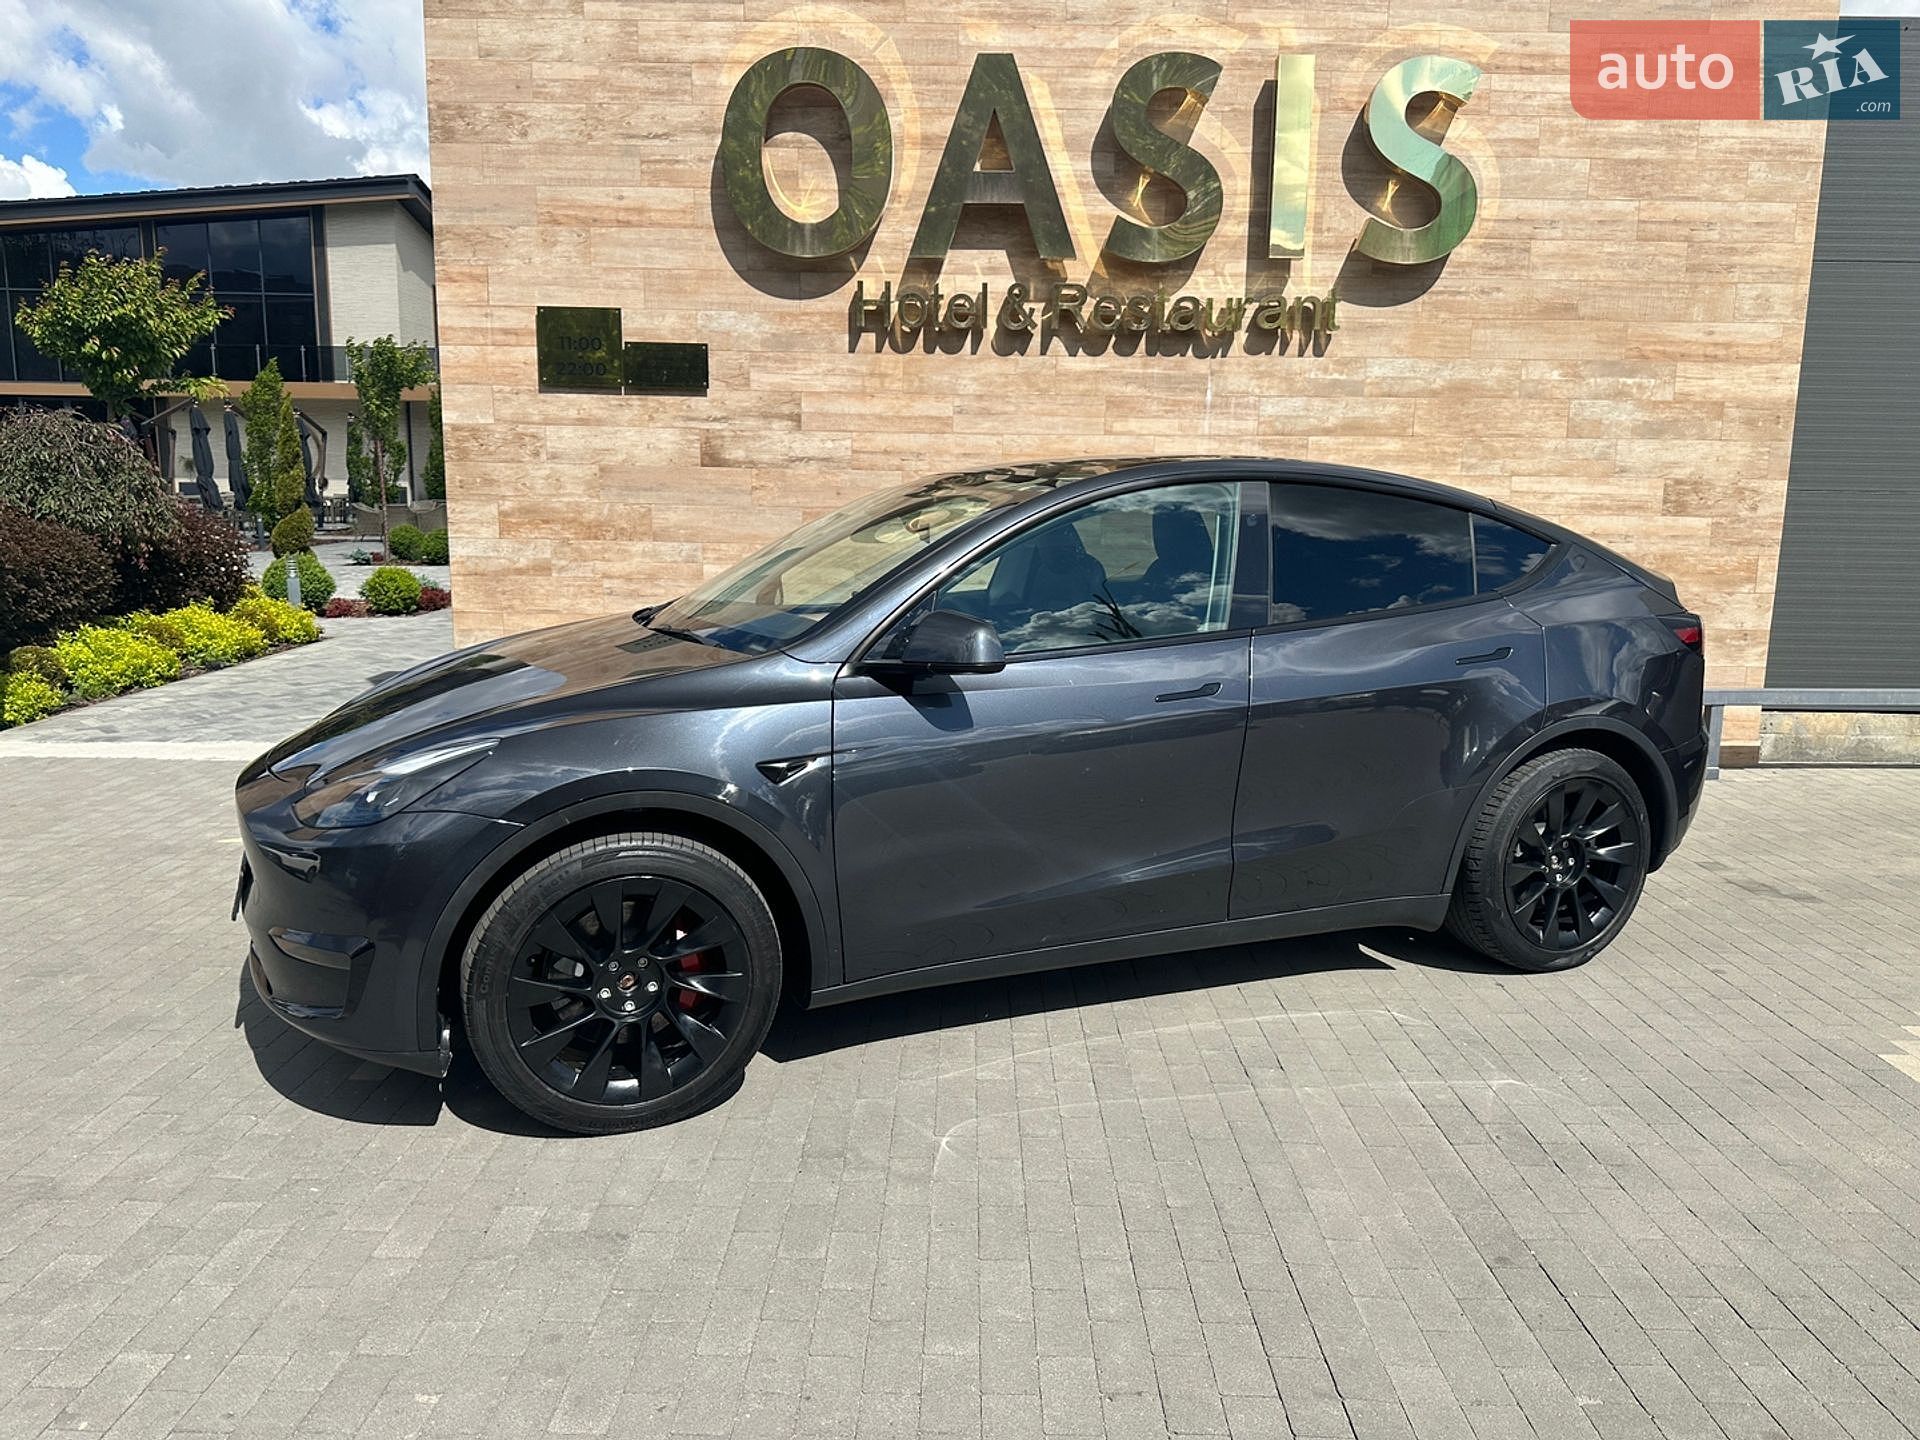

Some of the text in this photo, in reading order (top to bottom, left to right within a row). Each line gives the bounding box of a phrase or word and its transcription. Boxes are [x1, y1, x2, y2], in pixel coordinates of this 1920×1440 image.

[721, 45, 1484, 265] OASIS
[856, 280, 1341, 333] Hotel & Restaurant
[558, 335, 603, 351] 11:00
[556, 361, 607, 376] 22:00
